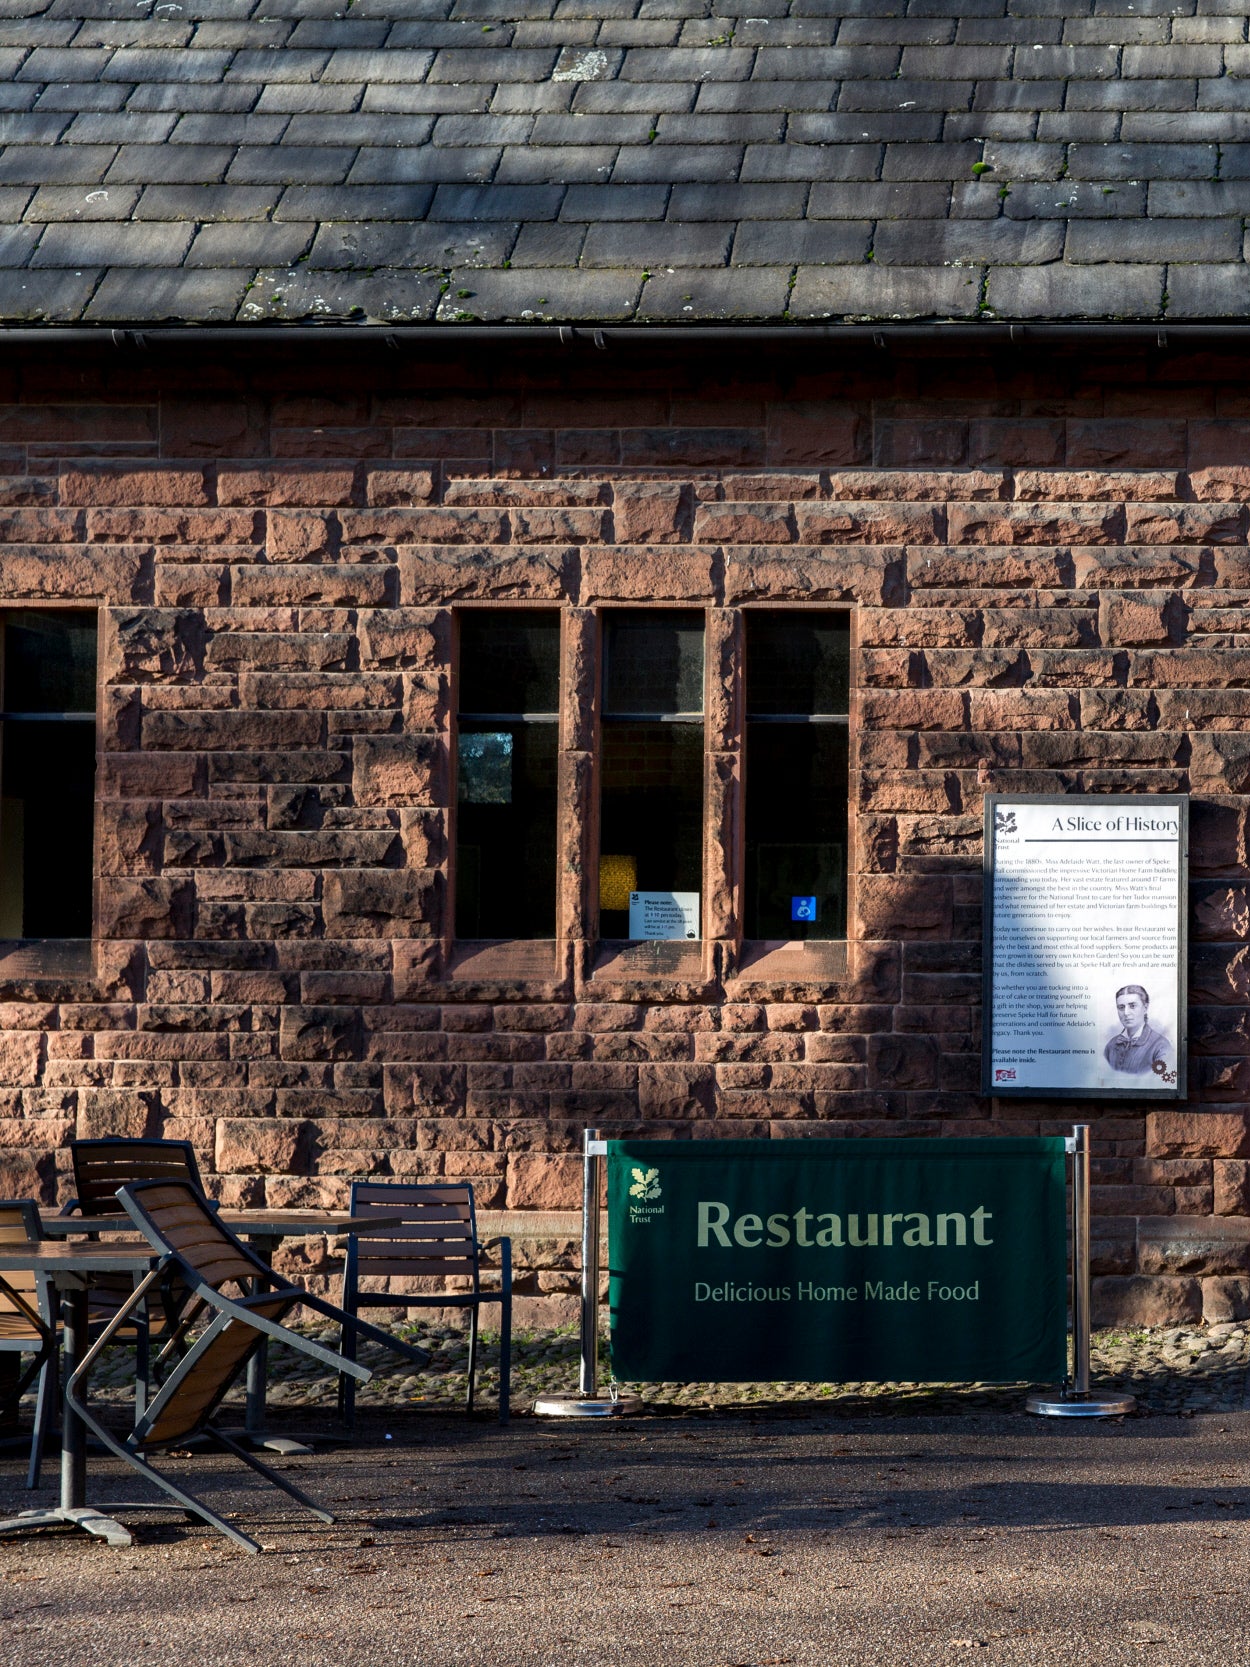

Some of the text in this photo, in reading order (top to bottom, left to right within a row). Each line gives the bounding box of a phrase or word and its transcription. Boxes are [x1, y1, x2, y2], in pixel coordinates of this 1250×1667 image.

[1052, 816, 1178, 835] A Slice of History
[630, 1205, 664, 1214] National
[630, 1214, 651, 1223] Trust
[697, 1201, 994, 1247] Restaurant
[695, 1280, 979, 1301] Delicious Home Made Food
